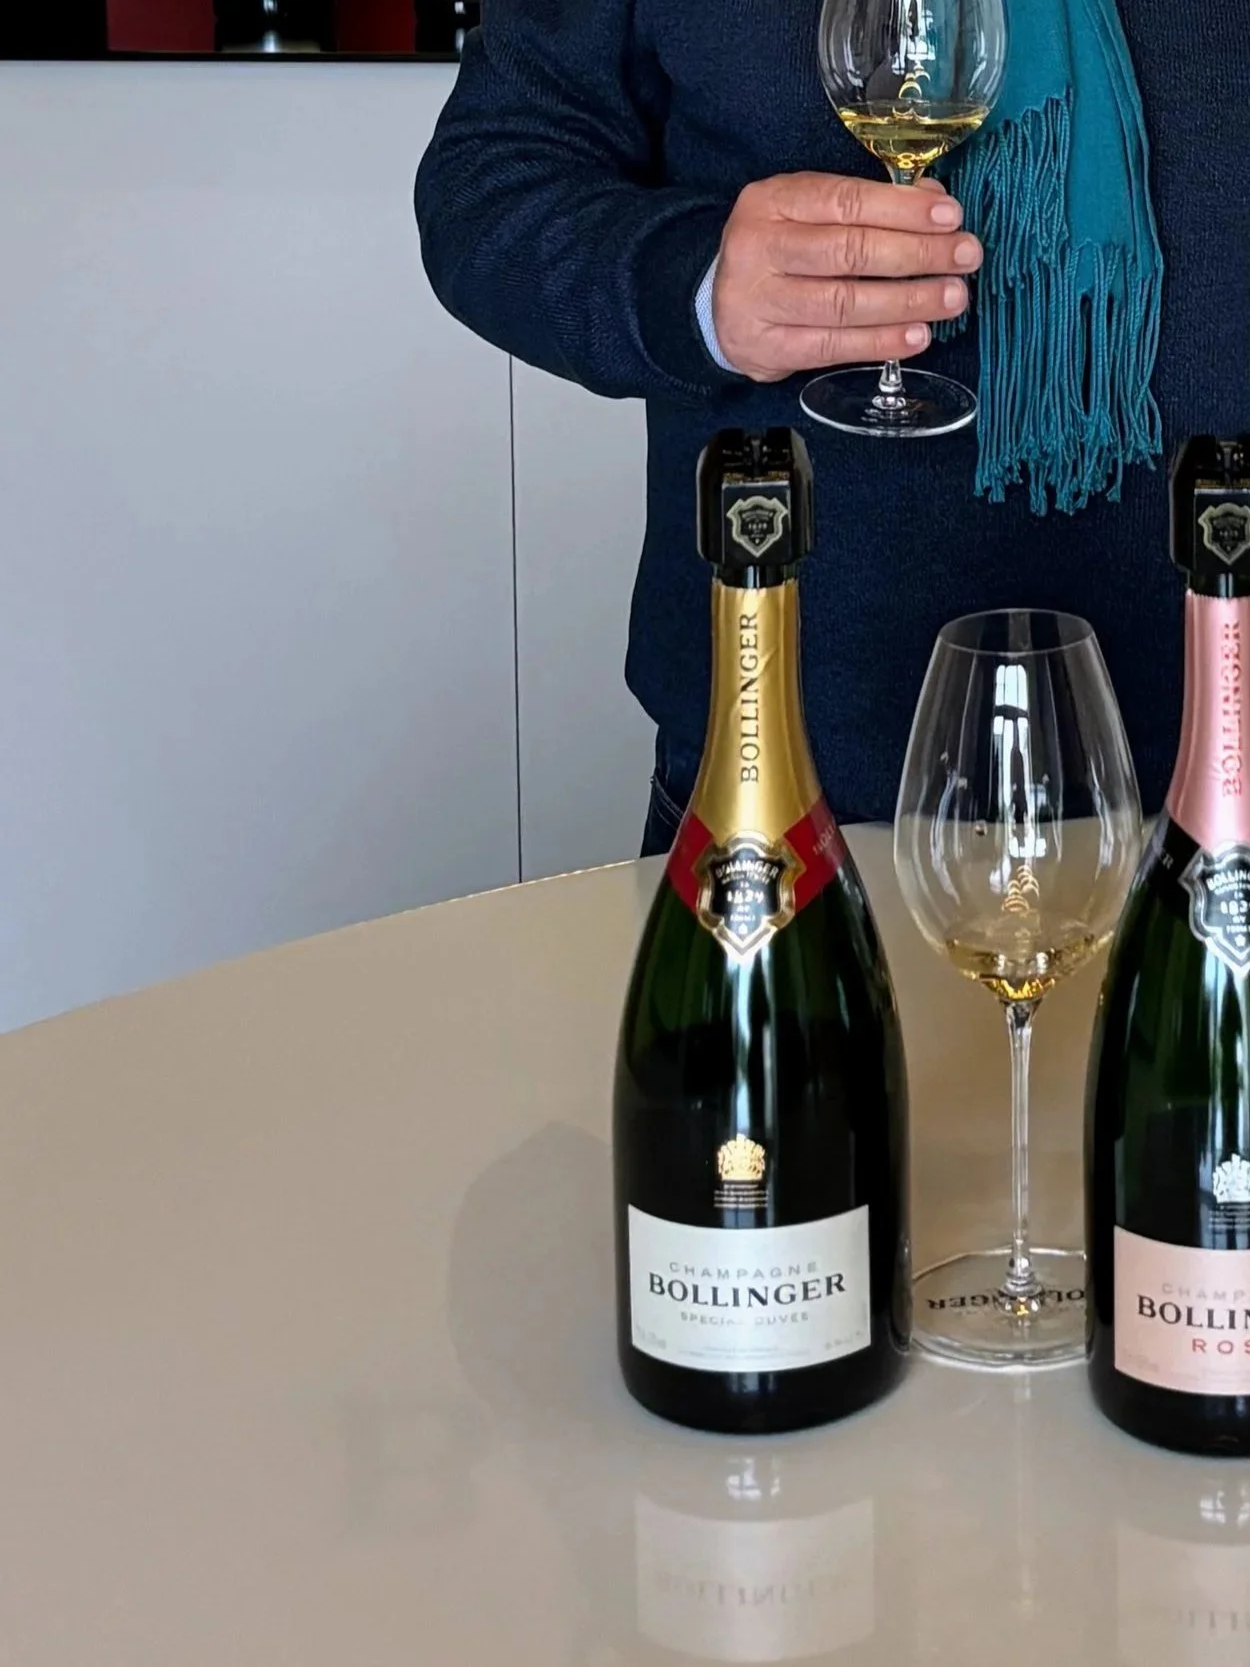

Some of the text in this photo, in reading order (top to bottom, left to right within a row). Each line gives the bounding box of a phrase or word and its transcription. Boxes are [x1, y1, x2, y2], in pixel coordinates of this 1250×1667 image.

[740, 611, 759, 783] BOLLINGER
[1220, 621, 1242, 796] BOLLINGER
[648, 1271, 846, 1308] BOLLINGER
[669, 1261, 819, 1281] CHAMPAGNE
